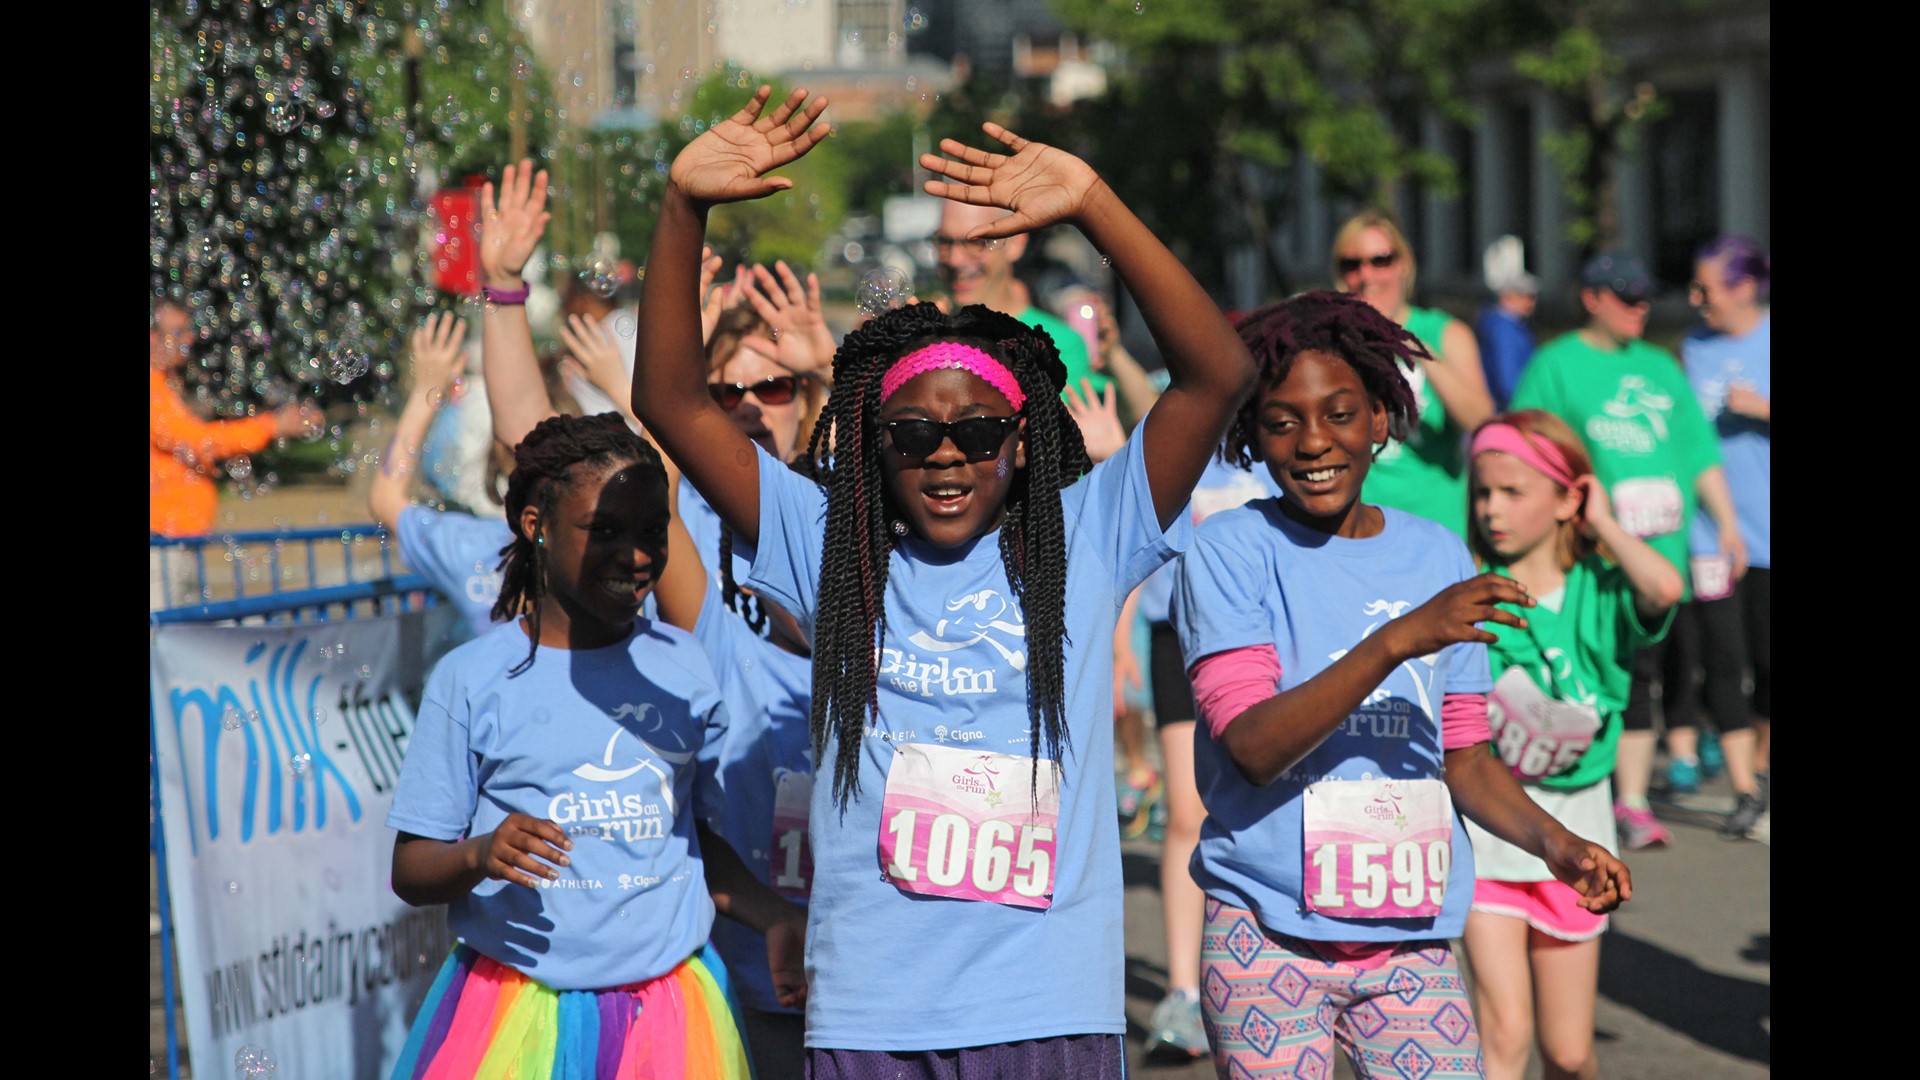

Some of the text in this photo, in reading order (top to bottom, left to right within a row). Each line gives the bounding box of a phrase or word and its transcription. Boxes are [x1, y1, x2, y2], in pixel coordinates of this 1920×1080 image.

[889, 677, 918, 693] the
[1393, 702, 1410, 713] on
[1346, 713, 1410, 738] run
[871, 729, 917, 741] ATLETA
[952, 774, 980, 787] Girls
[965, 785, 986, 795] run
[548, 790, 660, 824] Girls on
[568, 816, 664, 842] the run
[888, 808, 1054, 898] 1065
[1312, 840, 1450, 909] 1599
[552, 879, 603, 890] ATHLETA
